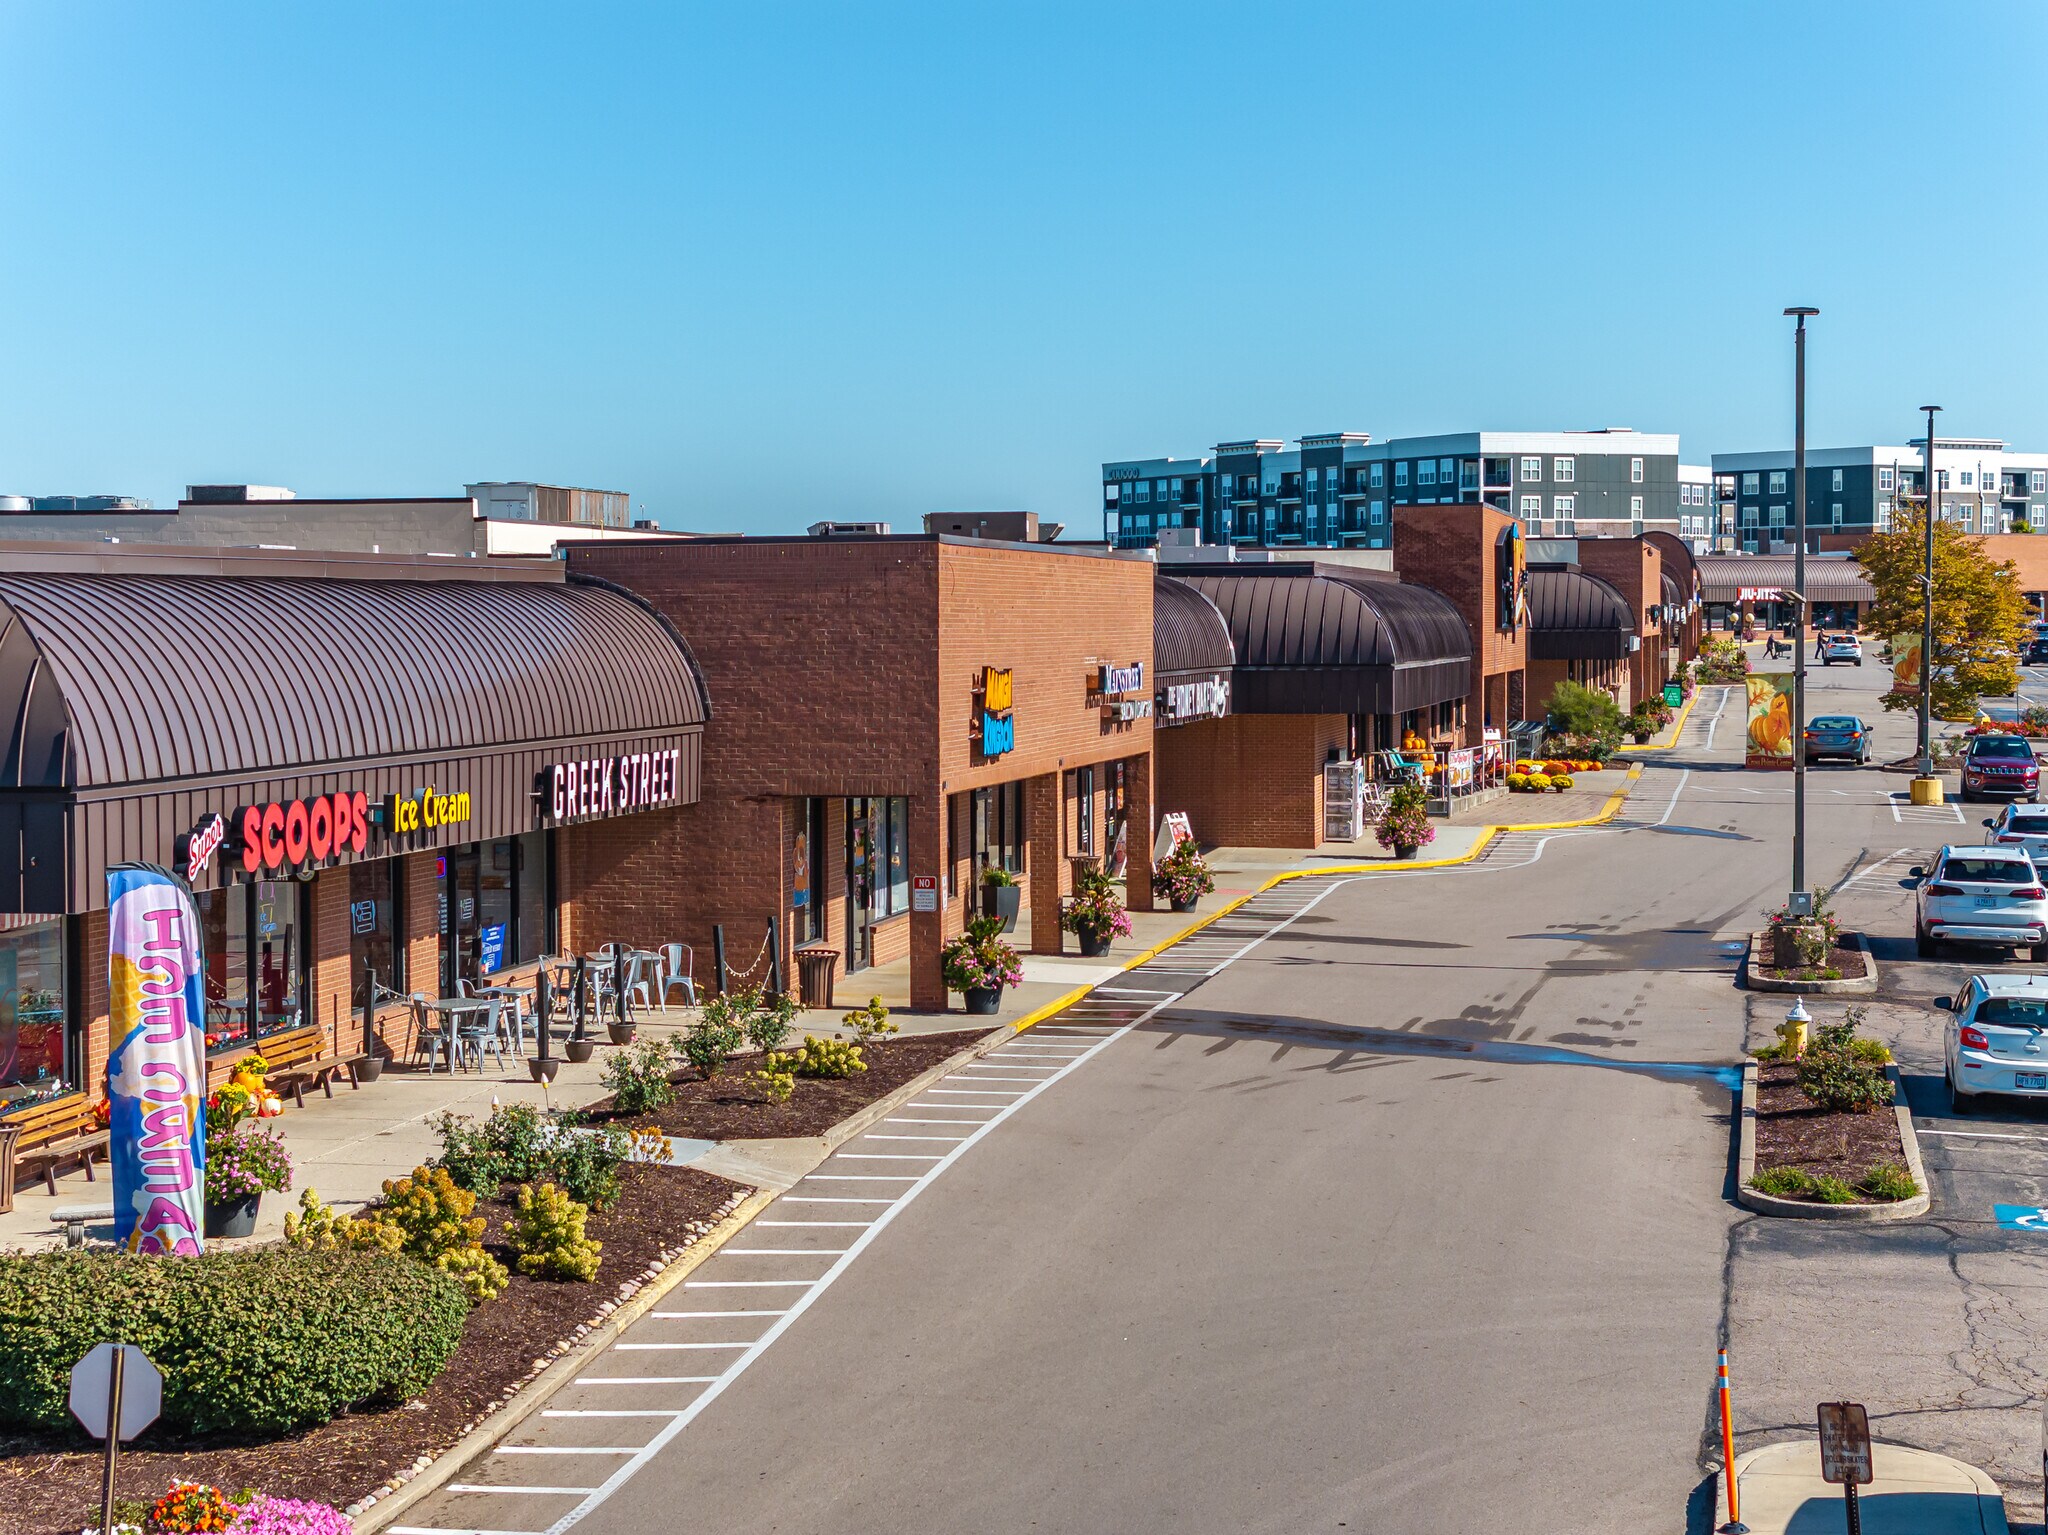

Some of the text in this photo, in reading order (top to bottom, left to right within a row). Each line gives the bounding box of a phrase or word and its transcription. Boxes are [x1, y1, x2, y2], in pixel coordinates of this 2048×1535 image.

[395, 787, 470, 833] Ice Cream
[554, 749, 679, 819] GREEK STREET
[188, 791, 368, 881] Super SCOOPS
[918, 878, 931, 888] NO
